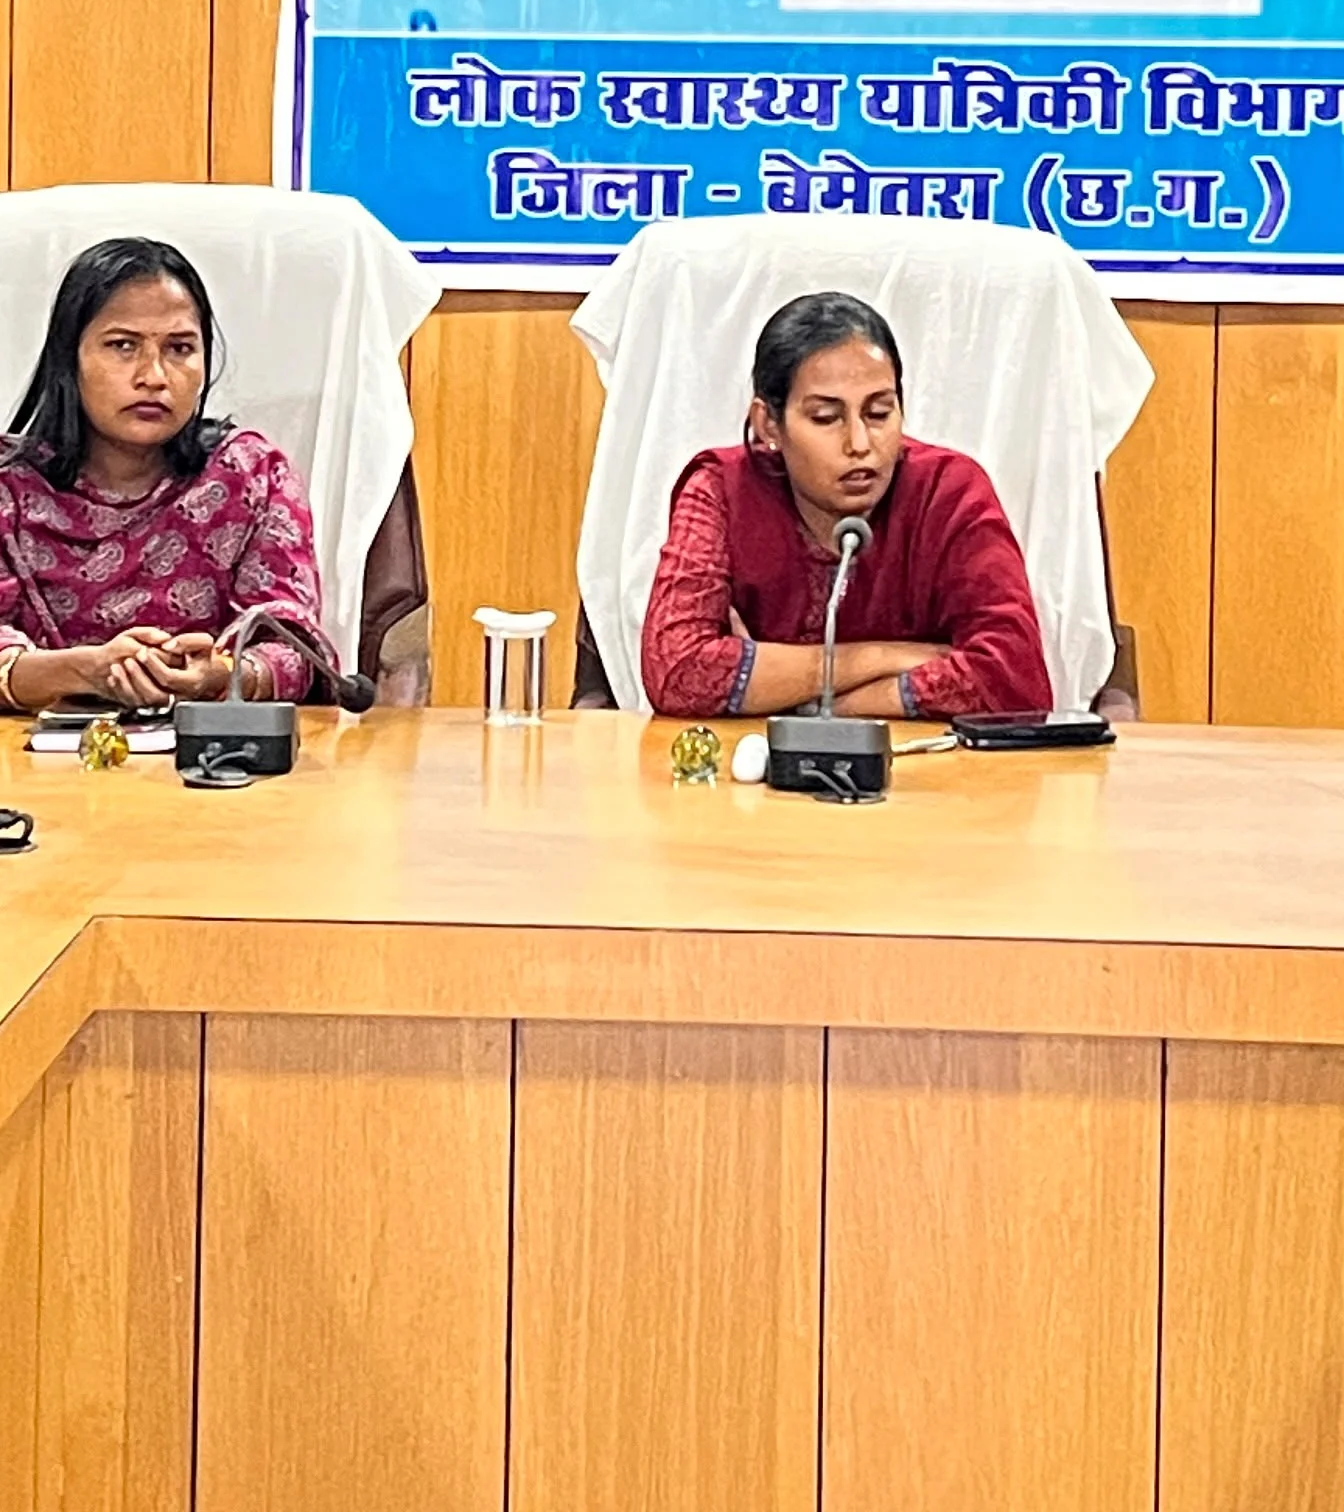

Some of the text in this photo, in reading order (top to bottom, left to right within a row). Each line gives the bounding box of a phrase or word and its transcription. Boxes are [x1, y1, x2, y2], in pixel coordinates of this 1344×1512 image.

[411, 57, 581, 122] लोक
[602, 76, 842, 126] स्वास्थ्य
[492, 152, 688, 217] जिला
[764, 154, 999, 220] बेमेतरा
[1028, 158, 1285, 239] (छ.ग.)
